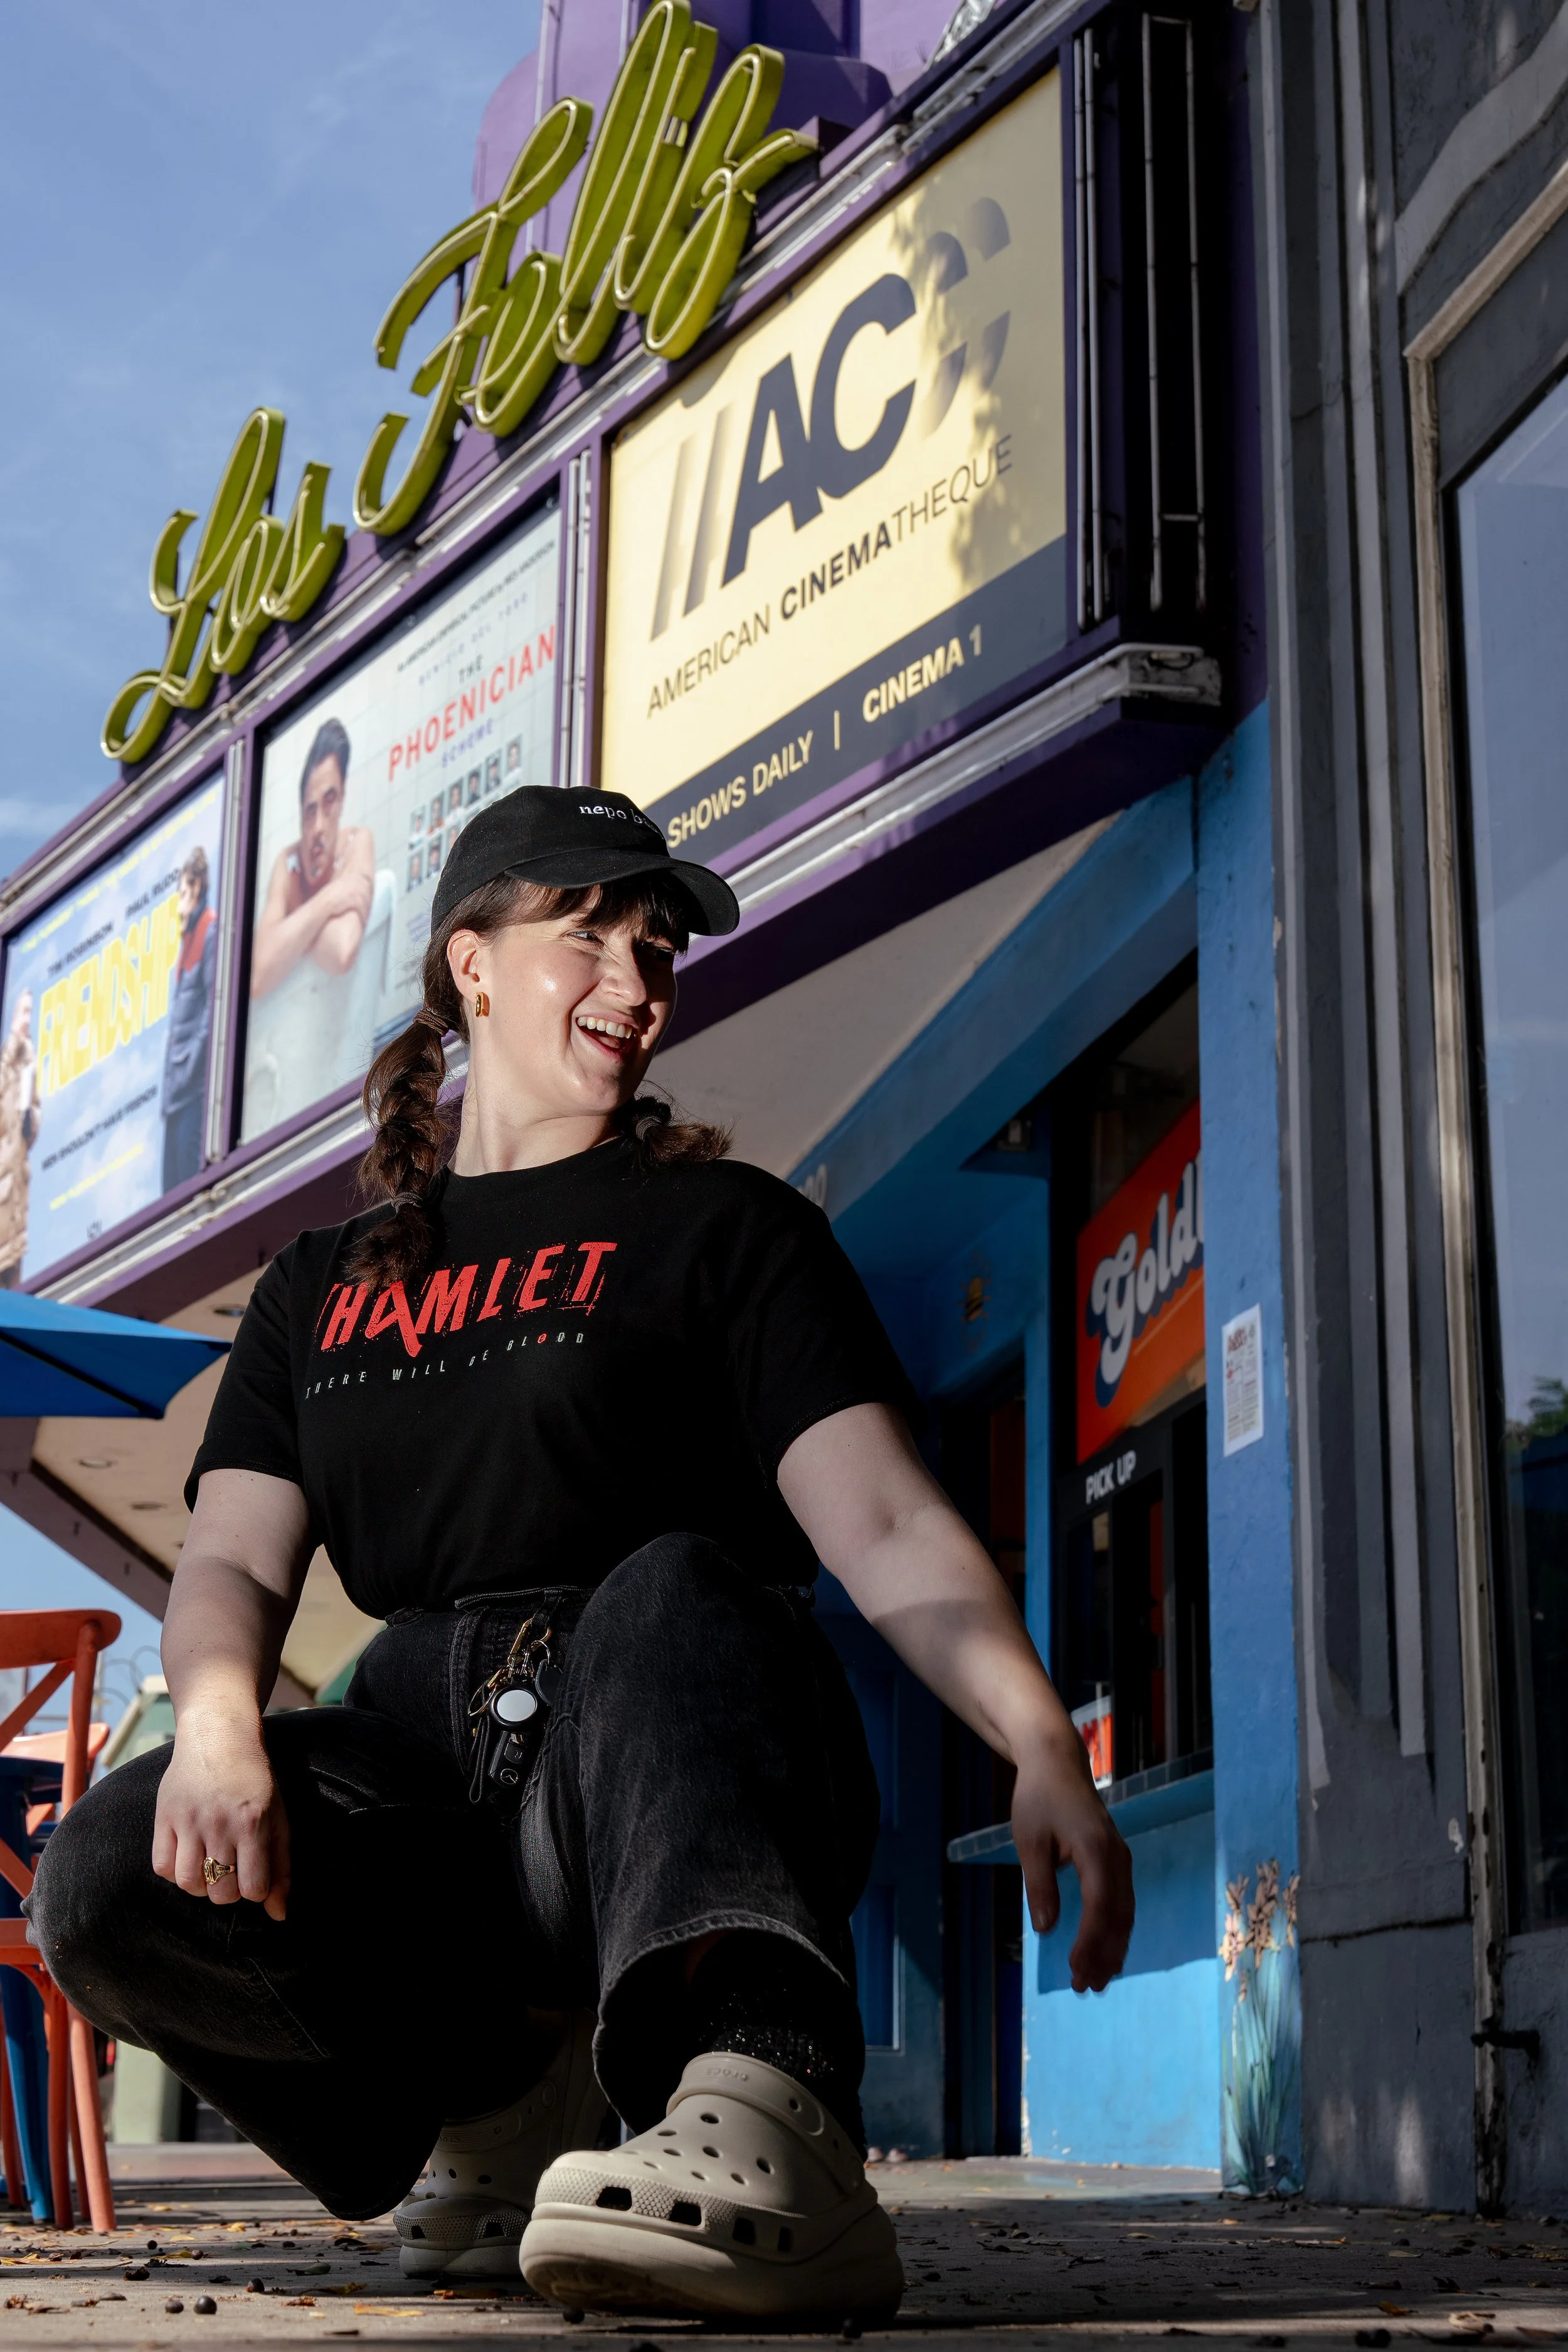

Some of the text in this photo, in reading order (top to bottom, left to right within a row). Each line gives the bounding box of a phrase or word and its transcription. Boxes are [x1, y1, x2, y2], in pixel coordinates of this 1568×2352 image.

[101, 0, 818, 763] Los Feliz
[647, 603, 770, 719] AMERICAN
[781, 434, 1012, 621] CINEMATHEQUE
[388, 625, 556, 781] PHOENICIAN
[667, 624, 983, 848] SHOWS DAILY CINEMA 1
[579, 805, 628, 820] nepo
[36, 892, 181, 1096] FRIENDSHIP
[305, 1332, 585, 1399] THERE WILL BE BLOOD
[315, 1242, 618, 1358] HAMLET
[1086, 1450, 1136, 1505] PICK UP
